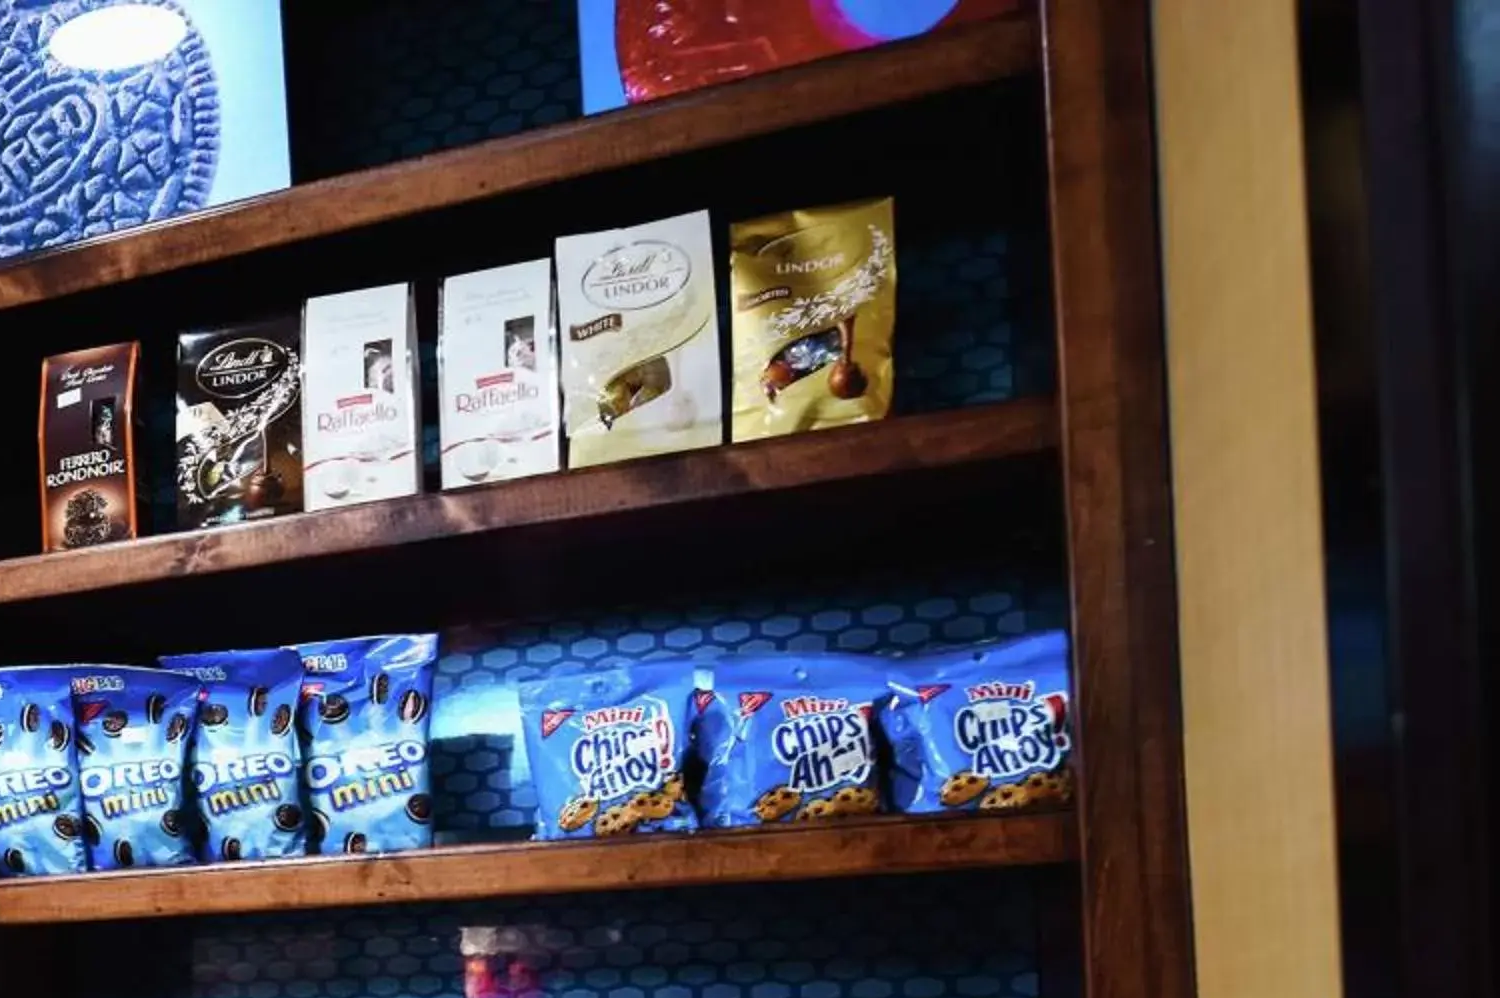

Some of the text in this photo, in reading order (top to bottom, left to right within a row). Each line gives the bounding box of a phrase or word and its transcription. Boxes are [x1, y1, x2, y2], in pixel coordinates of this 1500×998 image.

[776, 253, 845, 275] LINDOR
[604, 278, 671, 300] LINDOR
[576, 317, 615, 341] WHITE
[214, 349, 260, 370] Lindt
[212, 369, 268, 388] LINDOR
[455, 384, 540, 413] Raffaello
[317, 402, 398, 432] Raffaello
[59, 449, 110, 470] FERRERO
[46, 460, 125, 487] RONDNOIR
[968, 683, 1031, 701] Mini
[586, 708, 642, 730] Mini
[775, 713, 860, 763] Chips
[80, 760, 180, 797] OREO
[193, 752, 293, 793] OREO
[104, 786, 167, 817] mini
[209, 780, 280, 815] mini
[333, 769, 412, 810] mini
